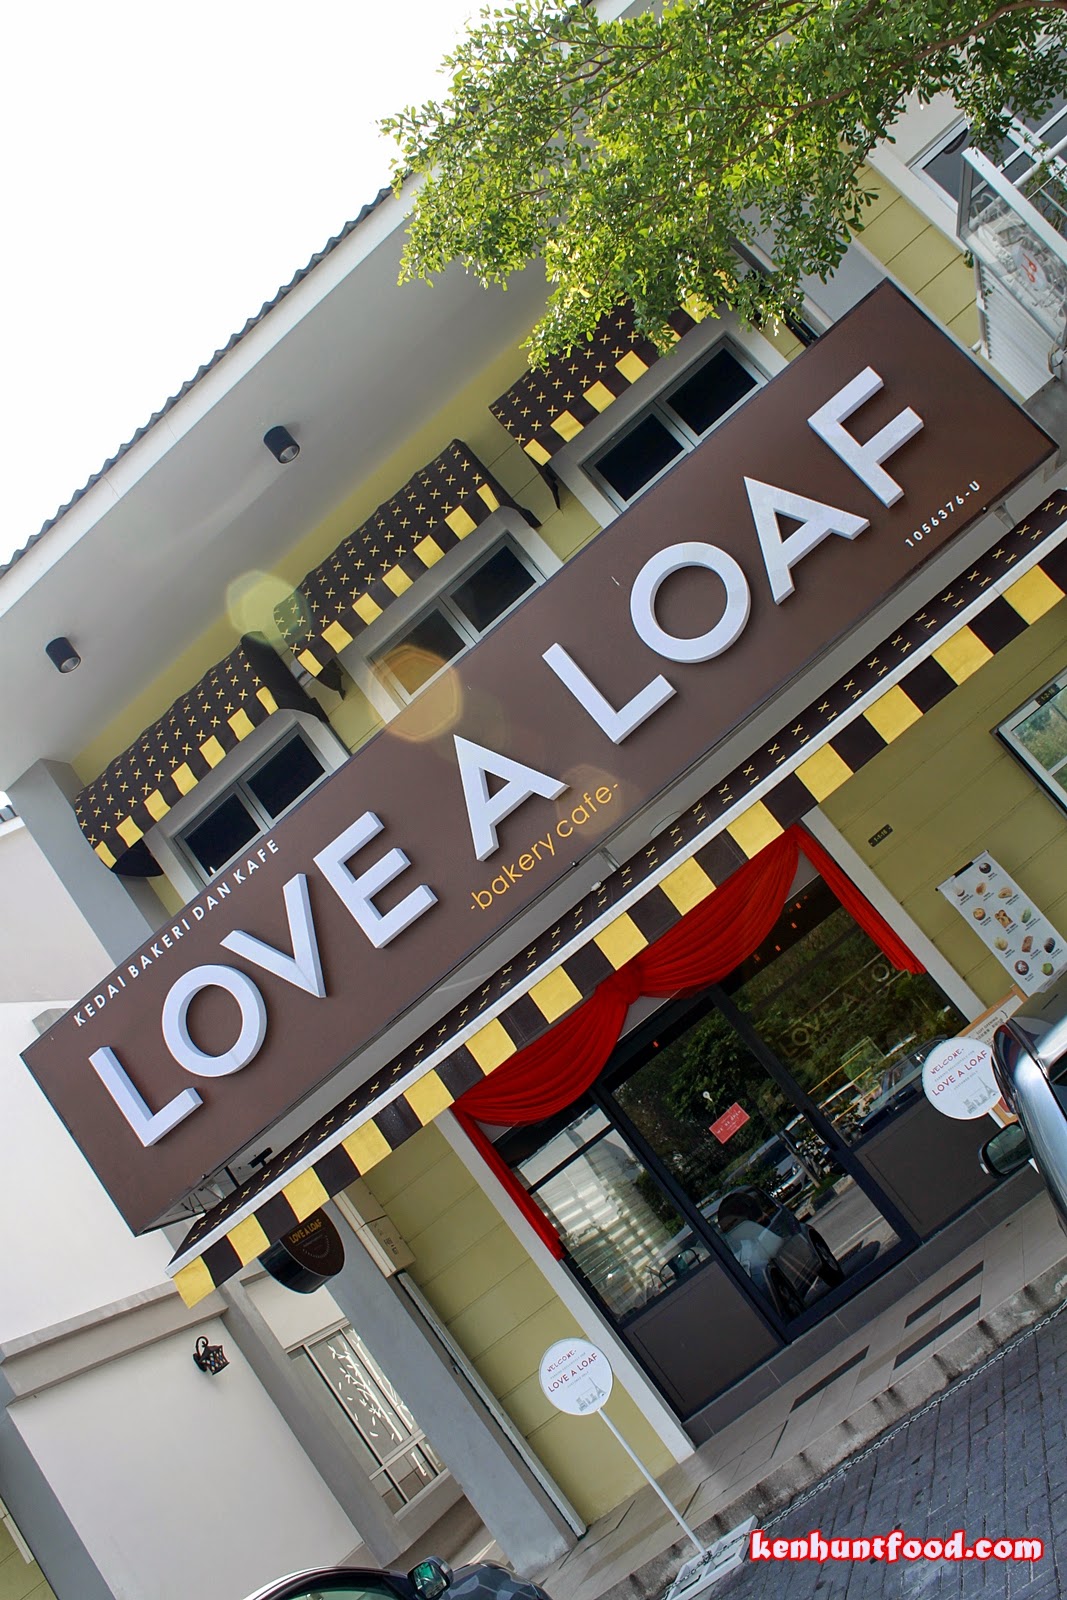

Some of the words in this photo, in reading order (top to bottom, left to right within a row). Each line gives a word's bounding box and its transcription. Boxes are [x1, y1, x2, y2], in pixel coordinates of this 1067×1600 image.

[904, 480, 982, 549] 1056376-U
[88, 810, 439, 1148] LOVE
[453, 734, 571, 862] A
[541, 365, 925, 745] LOAF
[470, 833, 556, 911] -bakery
[556, 783, 619, 838] cafe-
[73, 974, 127, 1028] KEDAI
[129, 918, 191, 979] BAKERI
[192, 884, 232, 921] DAN
[233, 838, 281, 892] KAFE
[932, 1075, 956, 1096] LOVE
[957, 1070, 965, 1078] A
[964, 1050, 988, 1071] LOAF
[289, 1229, 306, 1244] LOVE
[307, 1218, 322, 1233] LOAF
[547, 1374, 570, 1393] LOVE
[571, 1369, 577, 1378] A
[576, 1352, 598, 1371] LOAF
